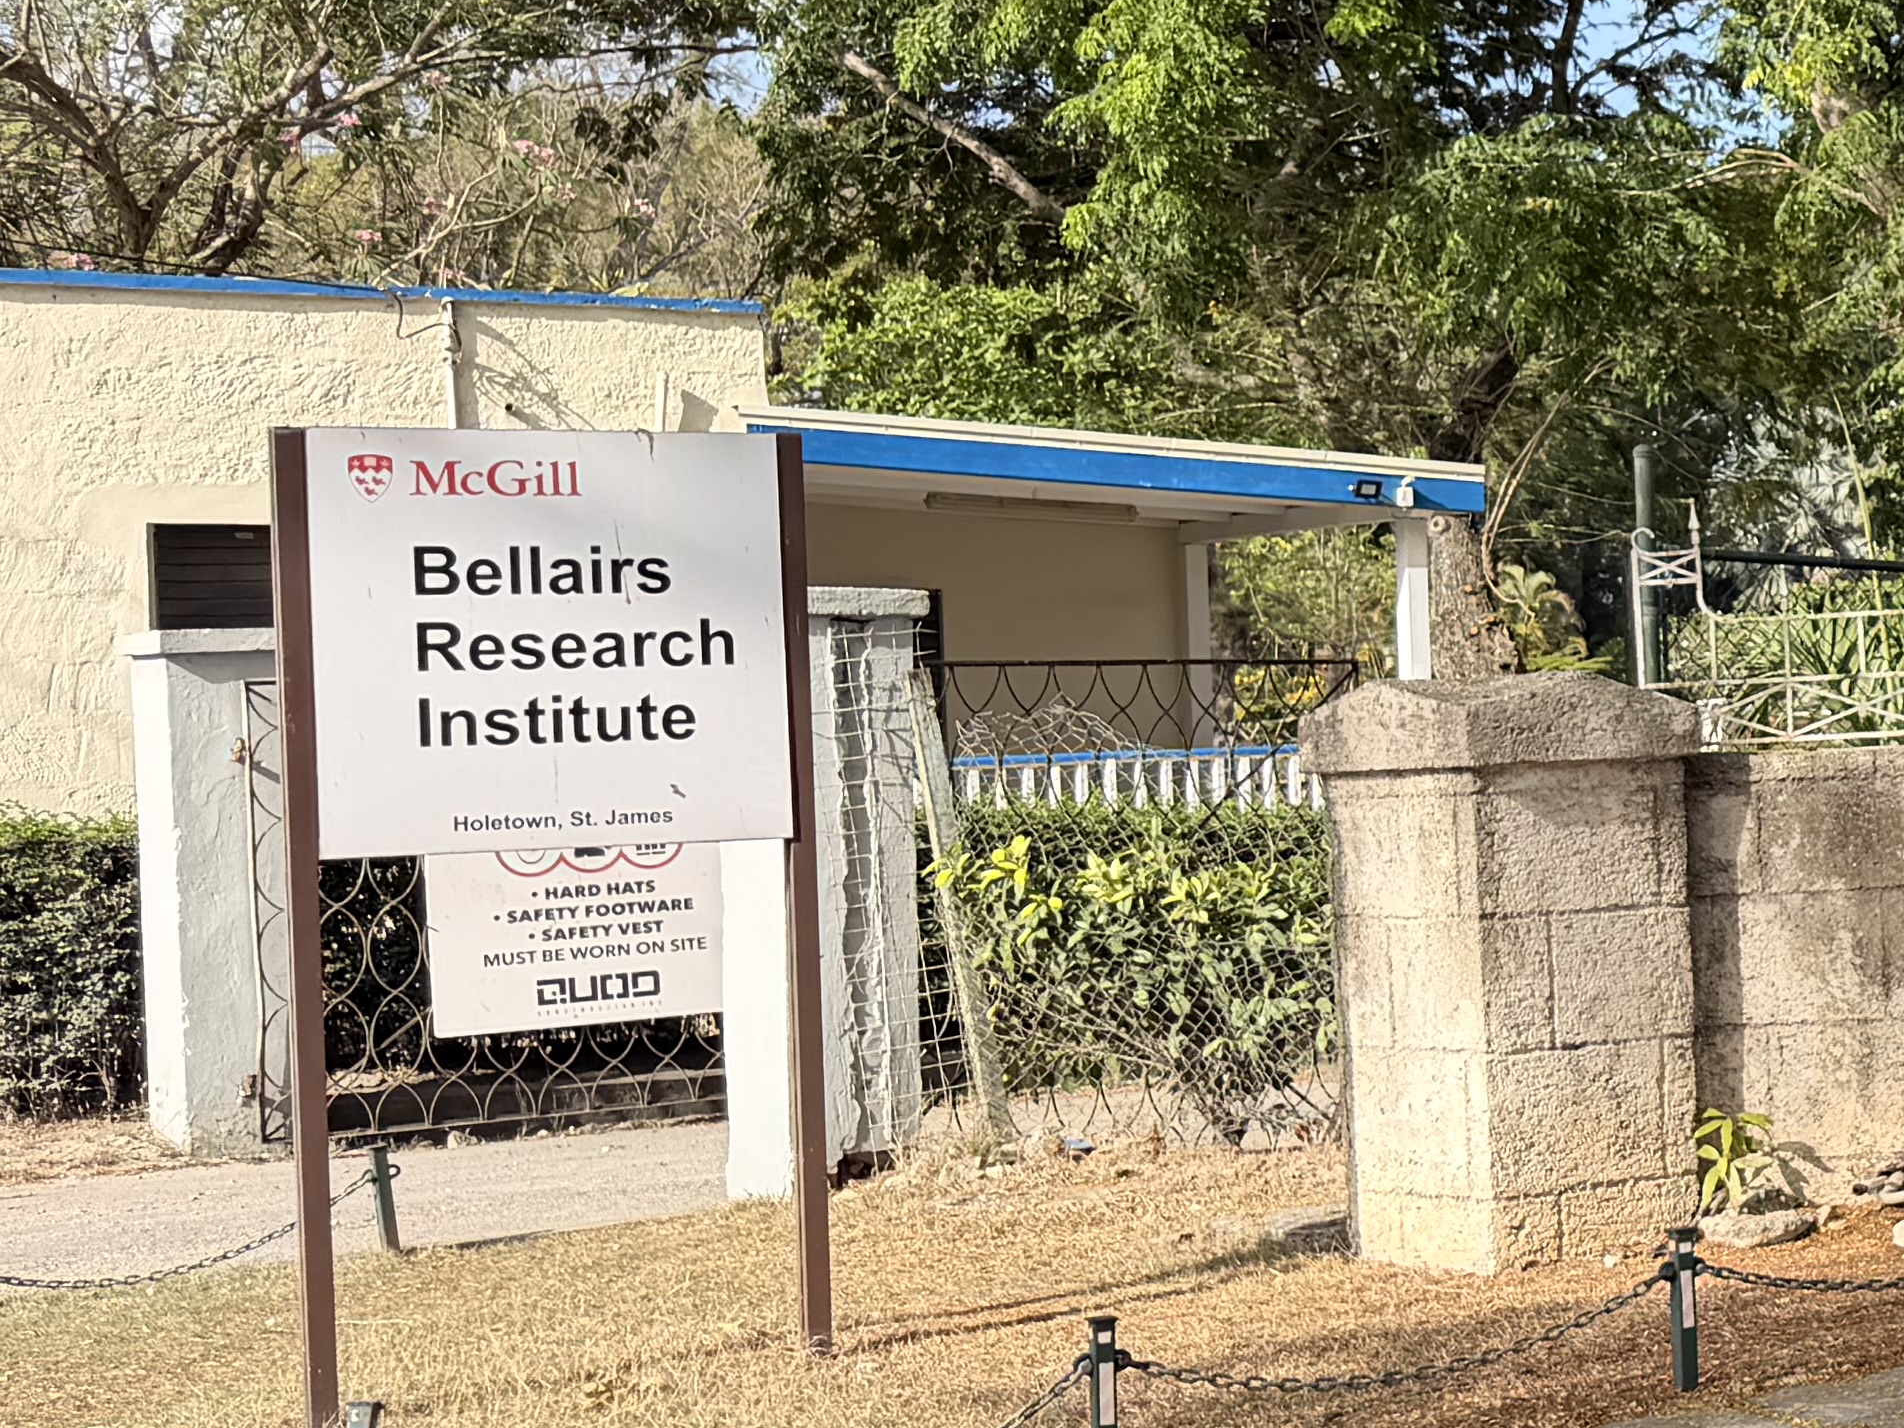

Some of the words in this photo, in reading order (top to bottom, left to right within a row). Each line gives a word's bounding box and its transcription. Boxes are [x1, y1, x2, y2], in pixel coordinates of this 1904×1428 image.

[409, 460, 582, 496] McGill
[413, 545, 671, 595] Bellairs
[416, 618, 734, 672] Research
[418, 694, 696, 747] Institute
[453, 814, 563, 832] Holetown,
[570, 811, 598, 827] St.
[605, 809, 673, 826] James
[544, 883, 601, 900] HARD
[606, 880, 656, 895] HATS
[507, 905, 580, 924] SAFETY
[585, 897, 695, 918] FOOTWARE
[541, 923, 613, 942] SAFETY
[618, 920, 664, 936] VEST
[483, 950, 537, 968] MUST
[542, 948, 565, 963] BE
[571, 943, 631, 960] WORN
[635, 940, 665, 955] ON
[670, 936, 707, 952] SITE
